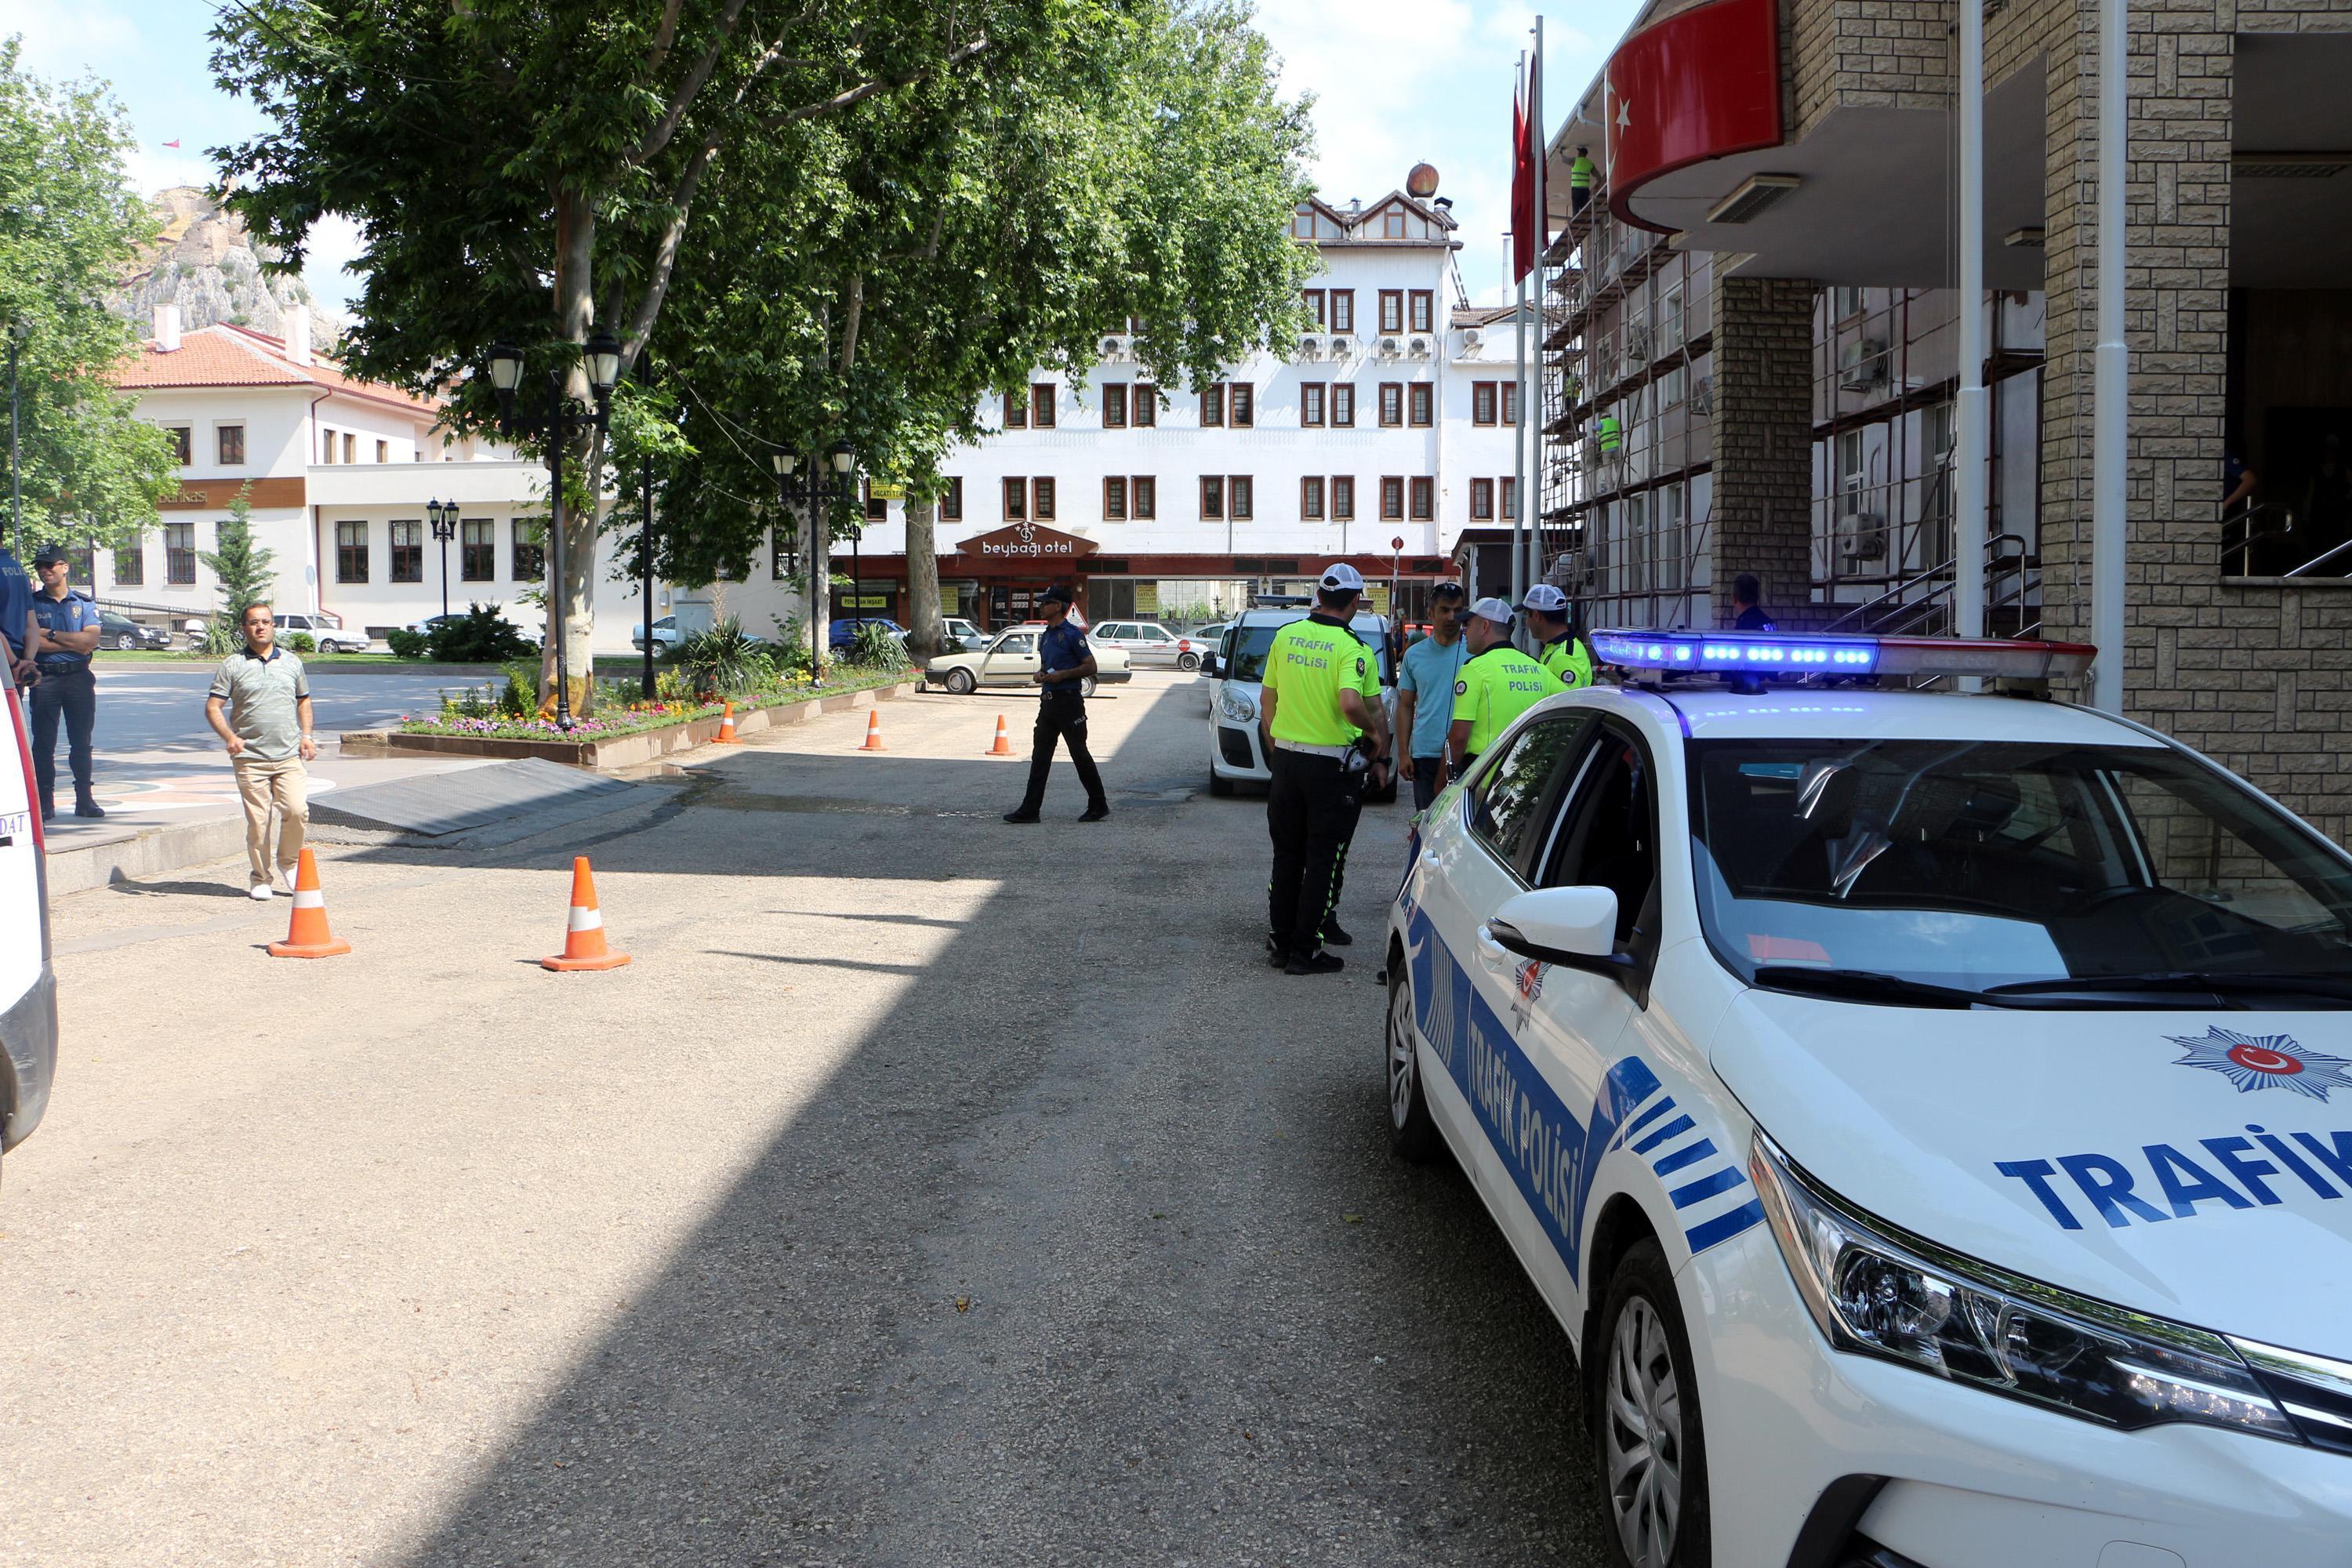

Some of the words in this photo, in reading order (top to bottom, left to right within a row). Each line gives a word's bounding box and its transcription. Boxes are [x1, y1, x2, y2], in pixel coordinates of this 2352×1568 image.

[982, 541, 1041, 557] beybağı
[1045, 541, 1072, 554] otel
[1469, 1019, 1518, 1159] TRAFİK
[1519, 1091, 1579, 1252] POLİSİ
